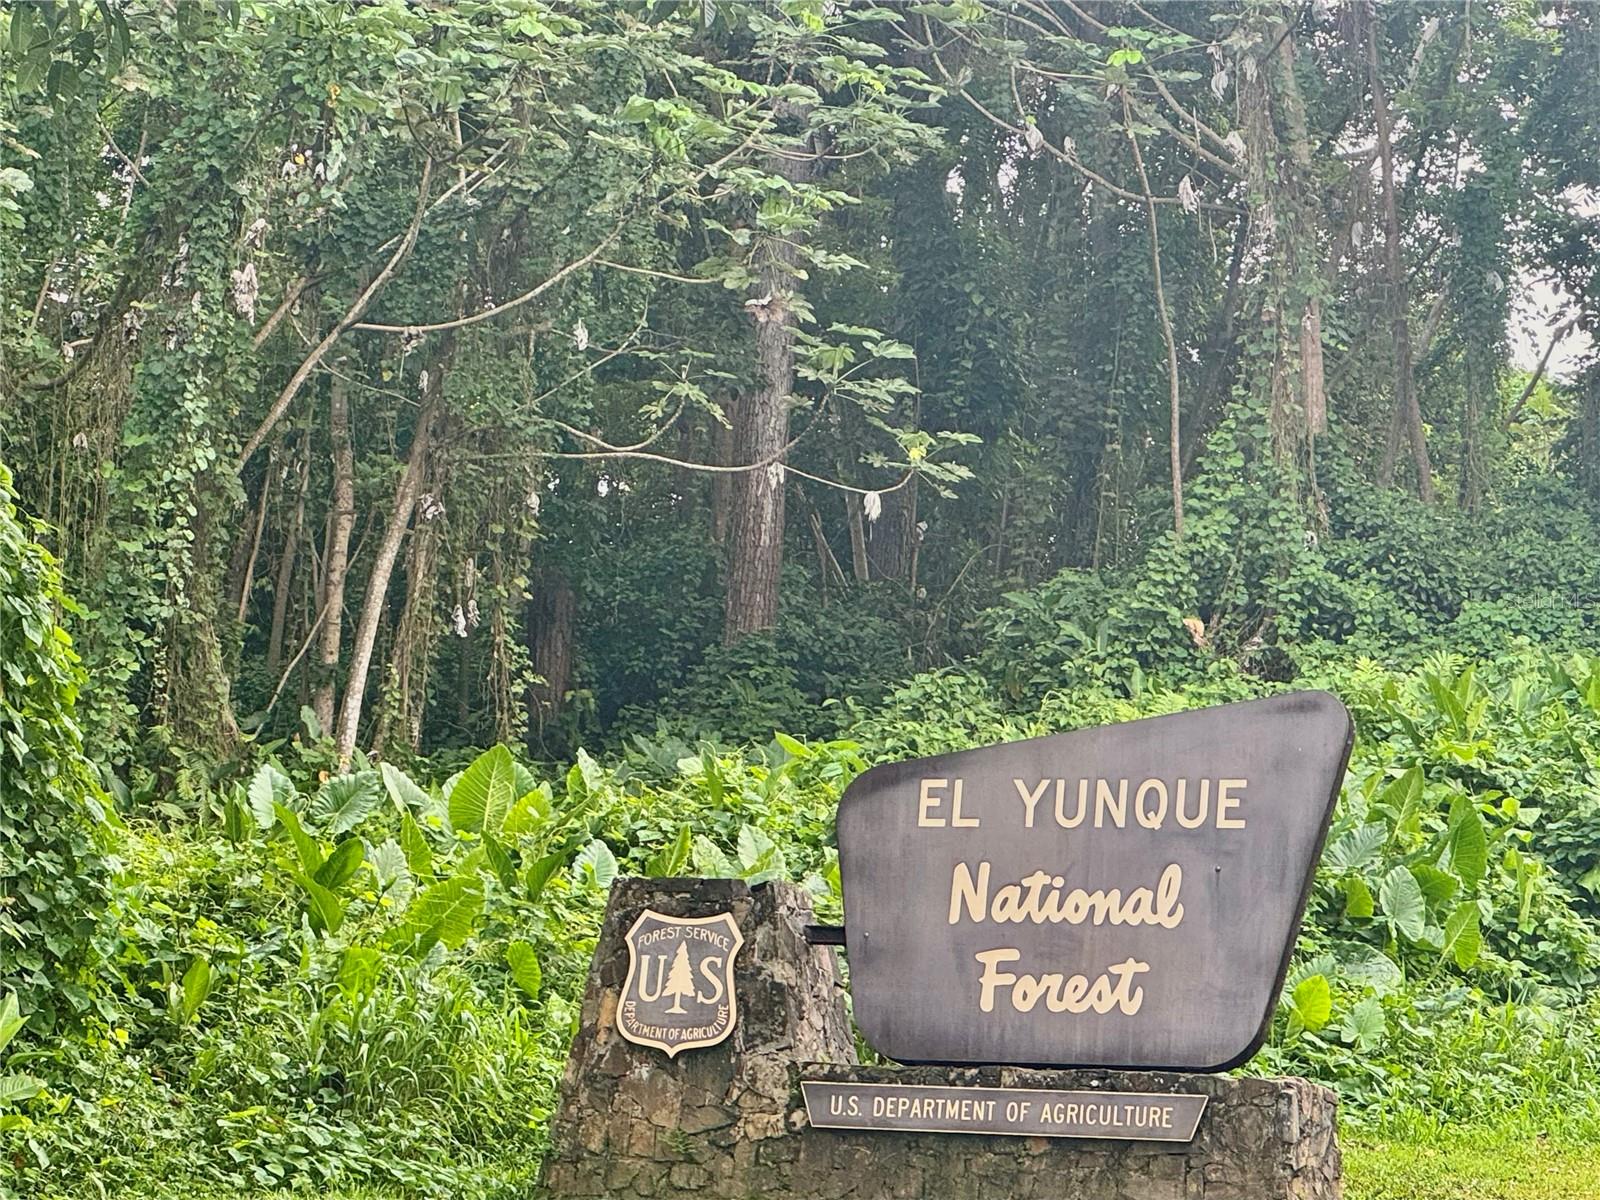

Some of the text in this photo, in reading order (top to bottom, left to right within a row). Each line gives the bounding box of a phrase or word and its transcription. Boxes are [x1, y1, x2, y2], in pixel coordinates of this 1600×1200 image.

[917, 778, 1248, 830] EL YUNQUE
[948, 861, 1184, 929] National
[638, 926, 730, 951] FOREST SERVICE
[975, 948, 1150, 1017] Forest
[623, 1000, 730, 1041] DEPARTMENT OF AGRICULTURE
[829, 1095, 1174, 1128] U.S. DEPARTMENT OF AGRICULTURE
